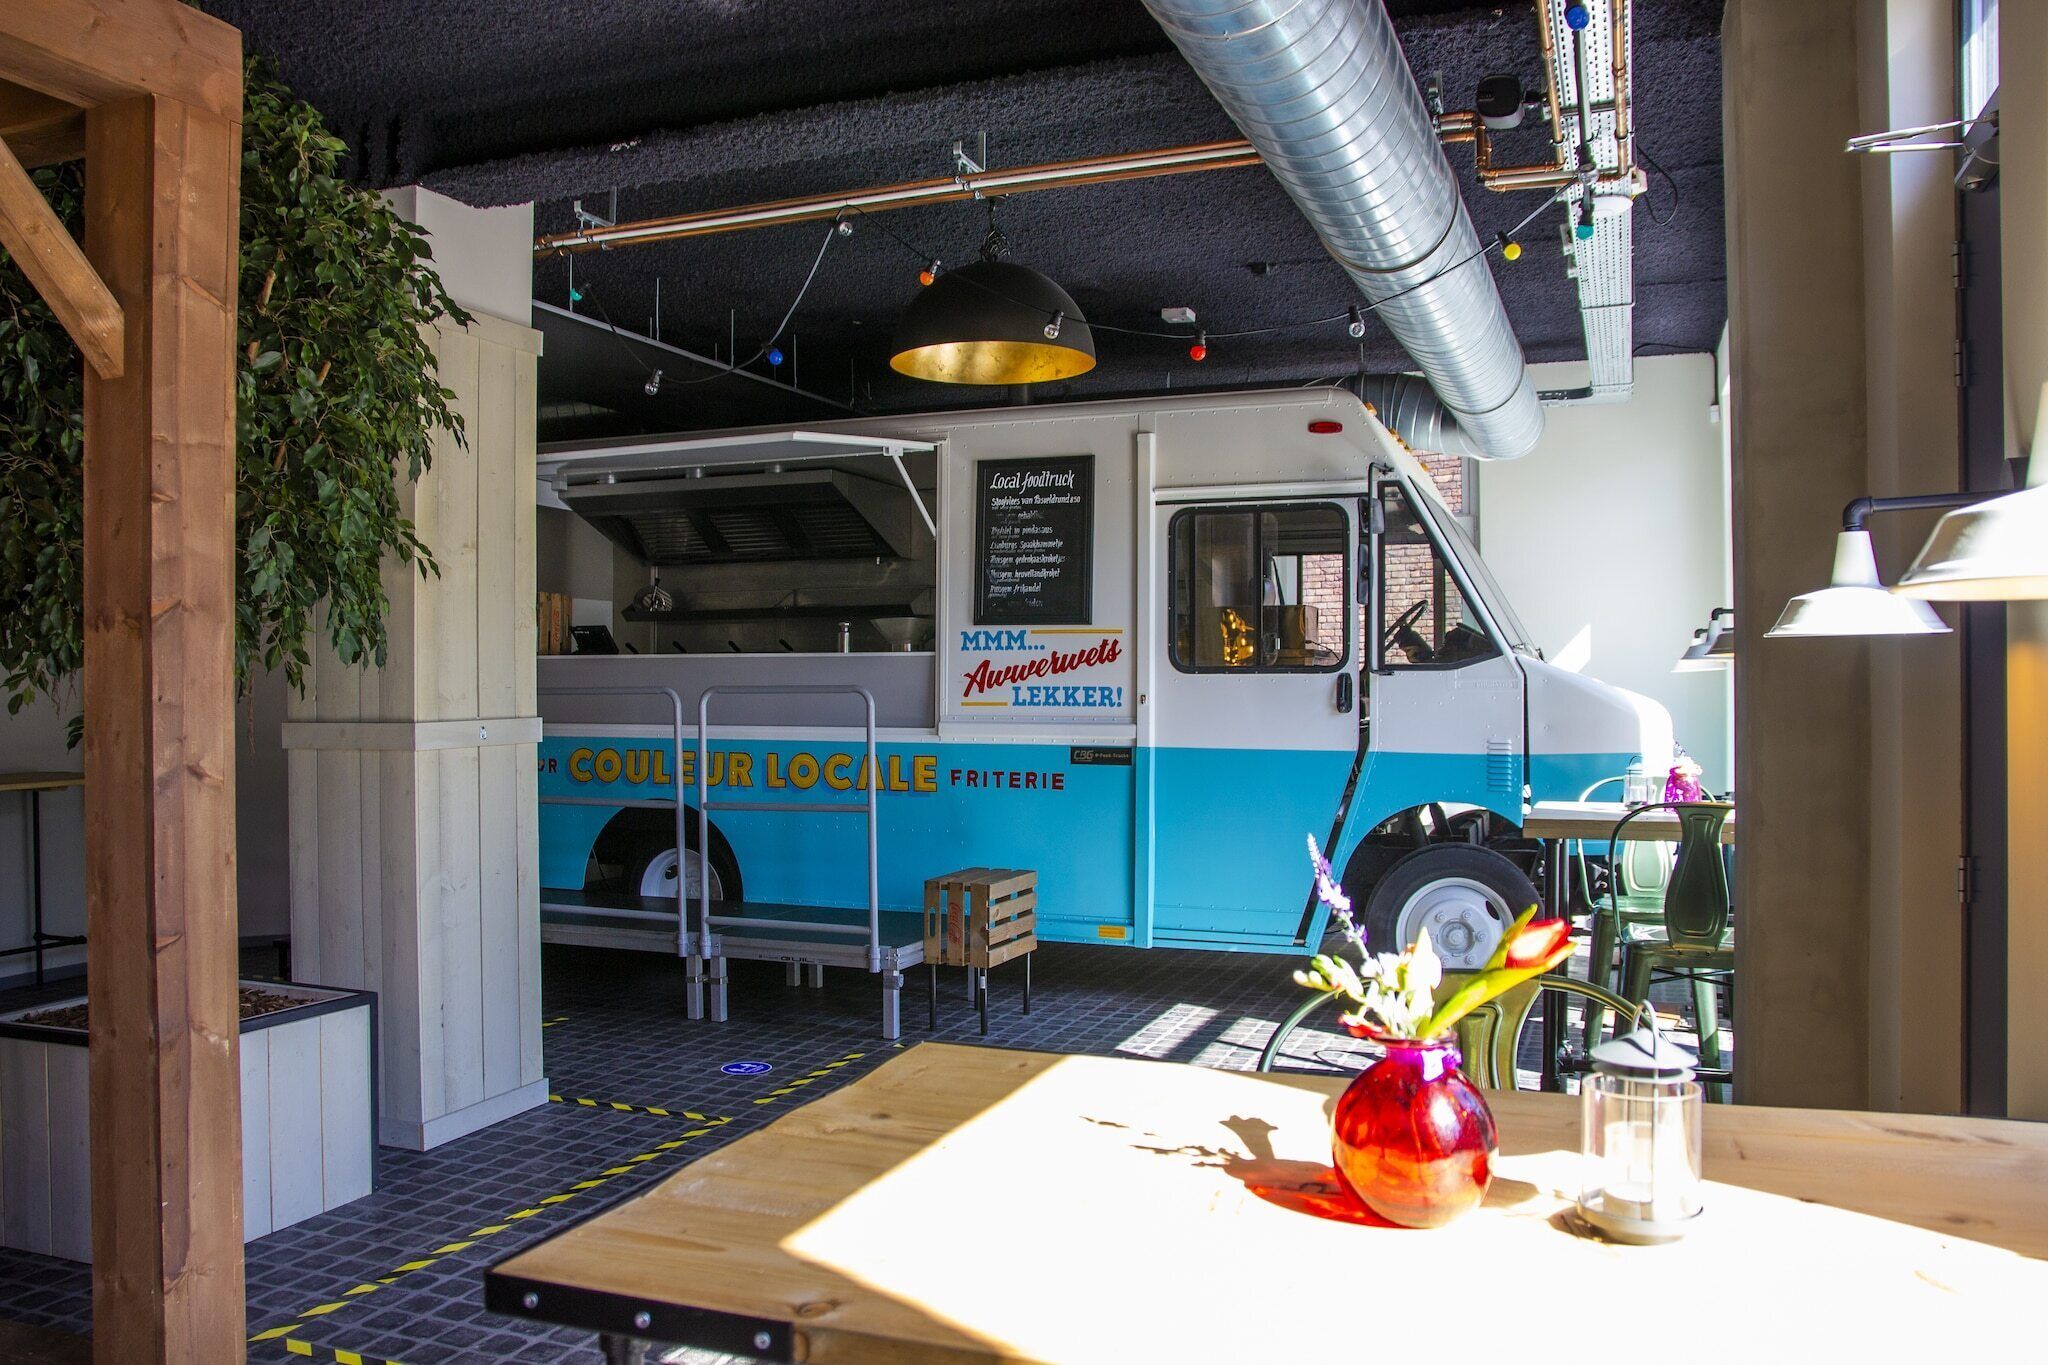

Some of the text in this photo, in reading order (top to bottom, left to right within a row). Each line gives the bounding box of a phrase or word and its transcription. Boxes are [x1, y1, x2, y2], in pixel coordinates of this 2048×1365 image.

[990, 469, 1075, 494] Local foodtruck
[1021, 497, 1033, 505] van
[961, 630, 1045, 651] MMM...
[1012, 686, 1123, 707] LEKKER!
[569, 748, 753, 787] COULEUR
[767, 752, 938, 792] LOCALE
[950, 769, 1065, 790] FRITERIE
